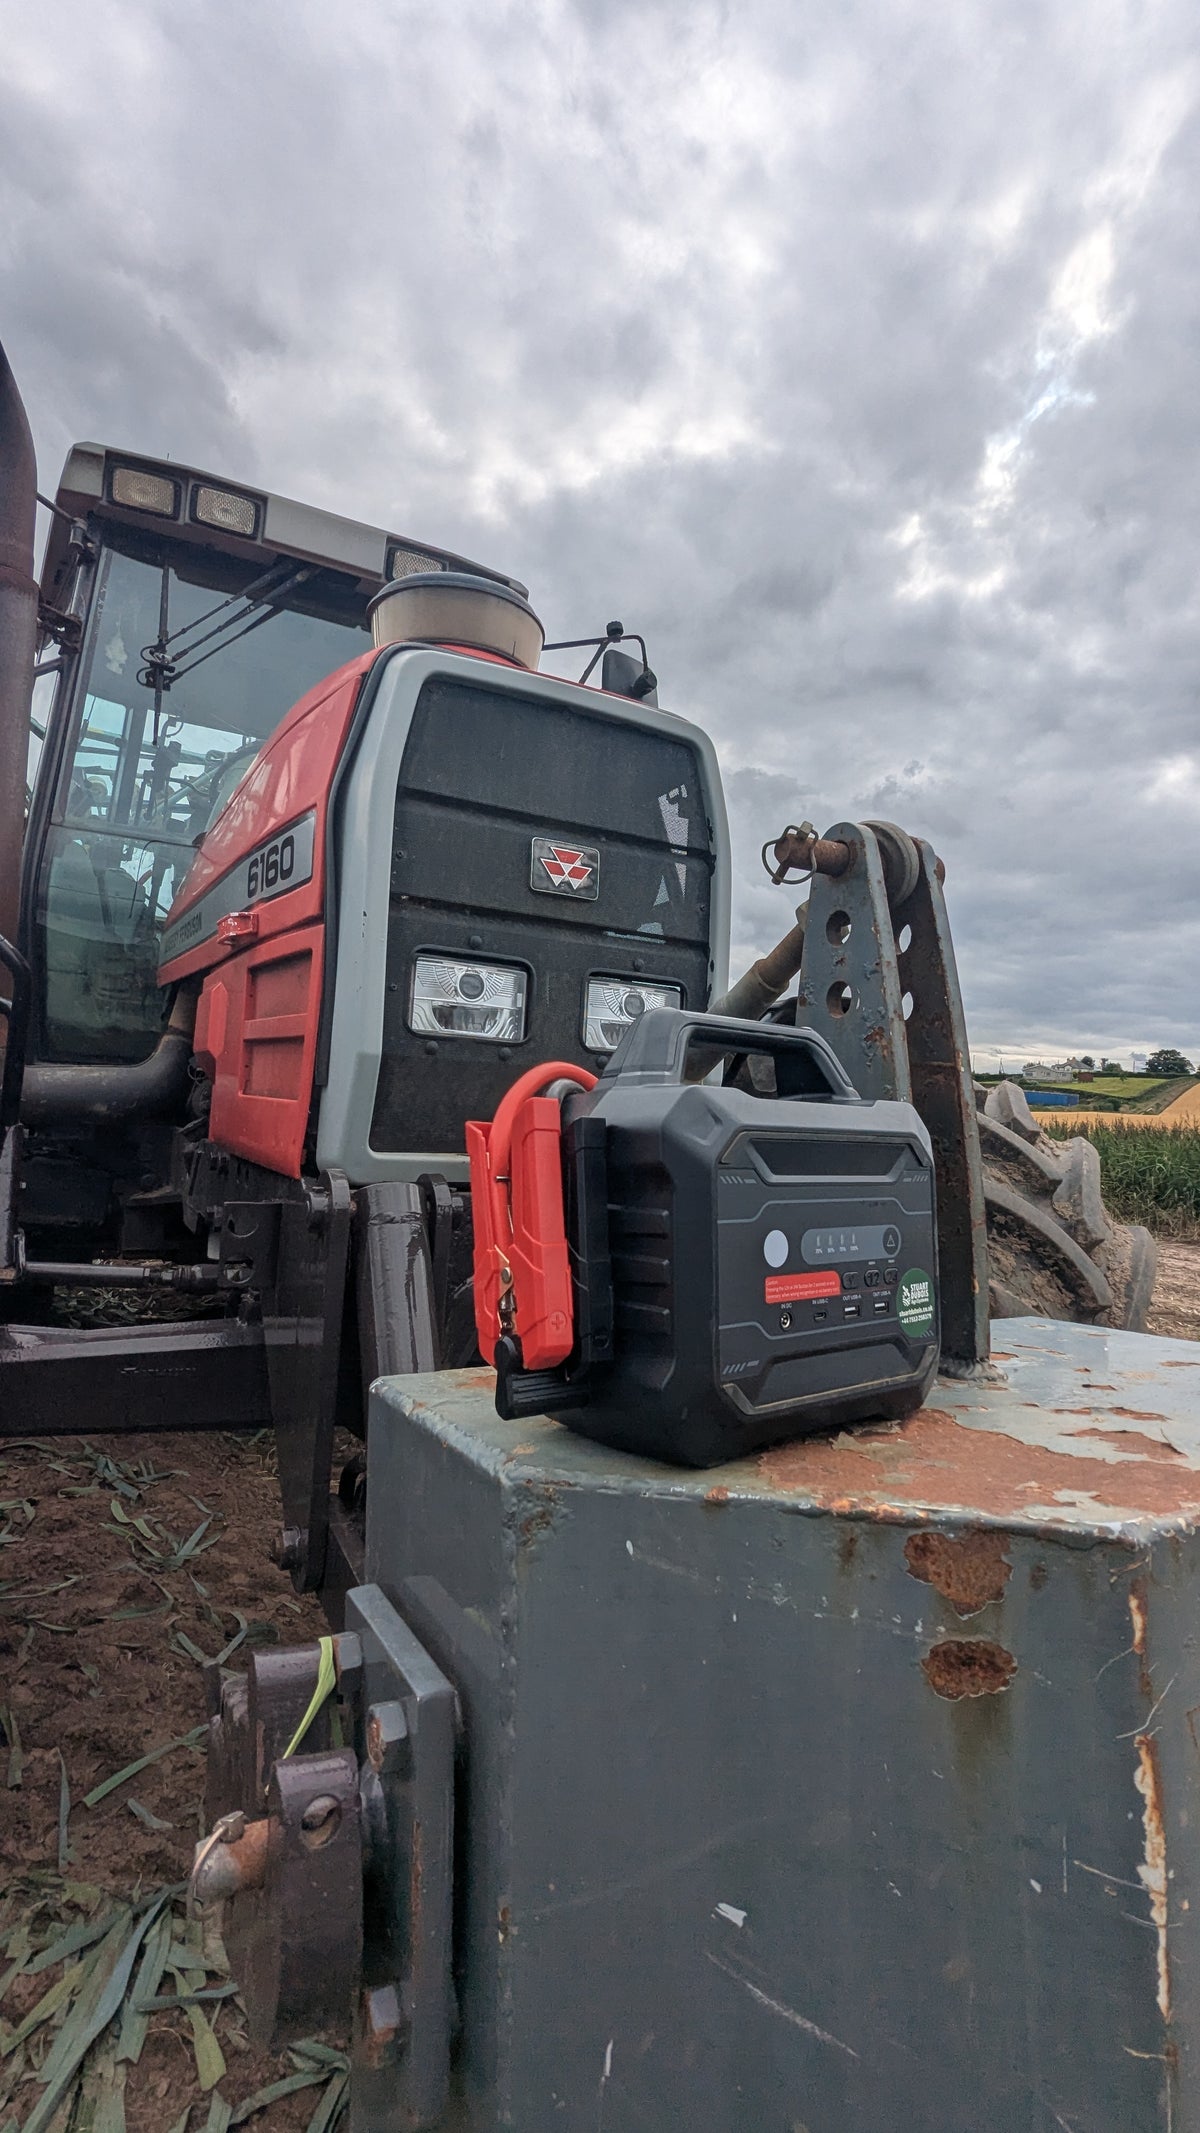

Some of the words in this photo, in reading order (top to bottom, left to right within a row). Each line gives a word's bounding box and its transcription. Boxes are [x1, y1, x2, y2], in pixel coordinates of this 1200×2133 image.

[247, 835, 294, 898] 6160
[910, 1282, 928, 1291] STUART
[910, 1290, 929, 1299] DUBOIS
